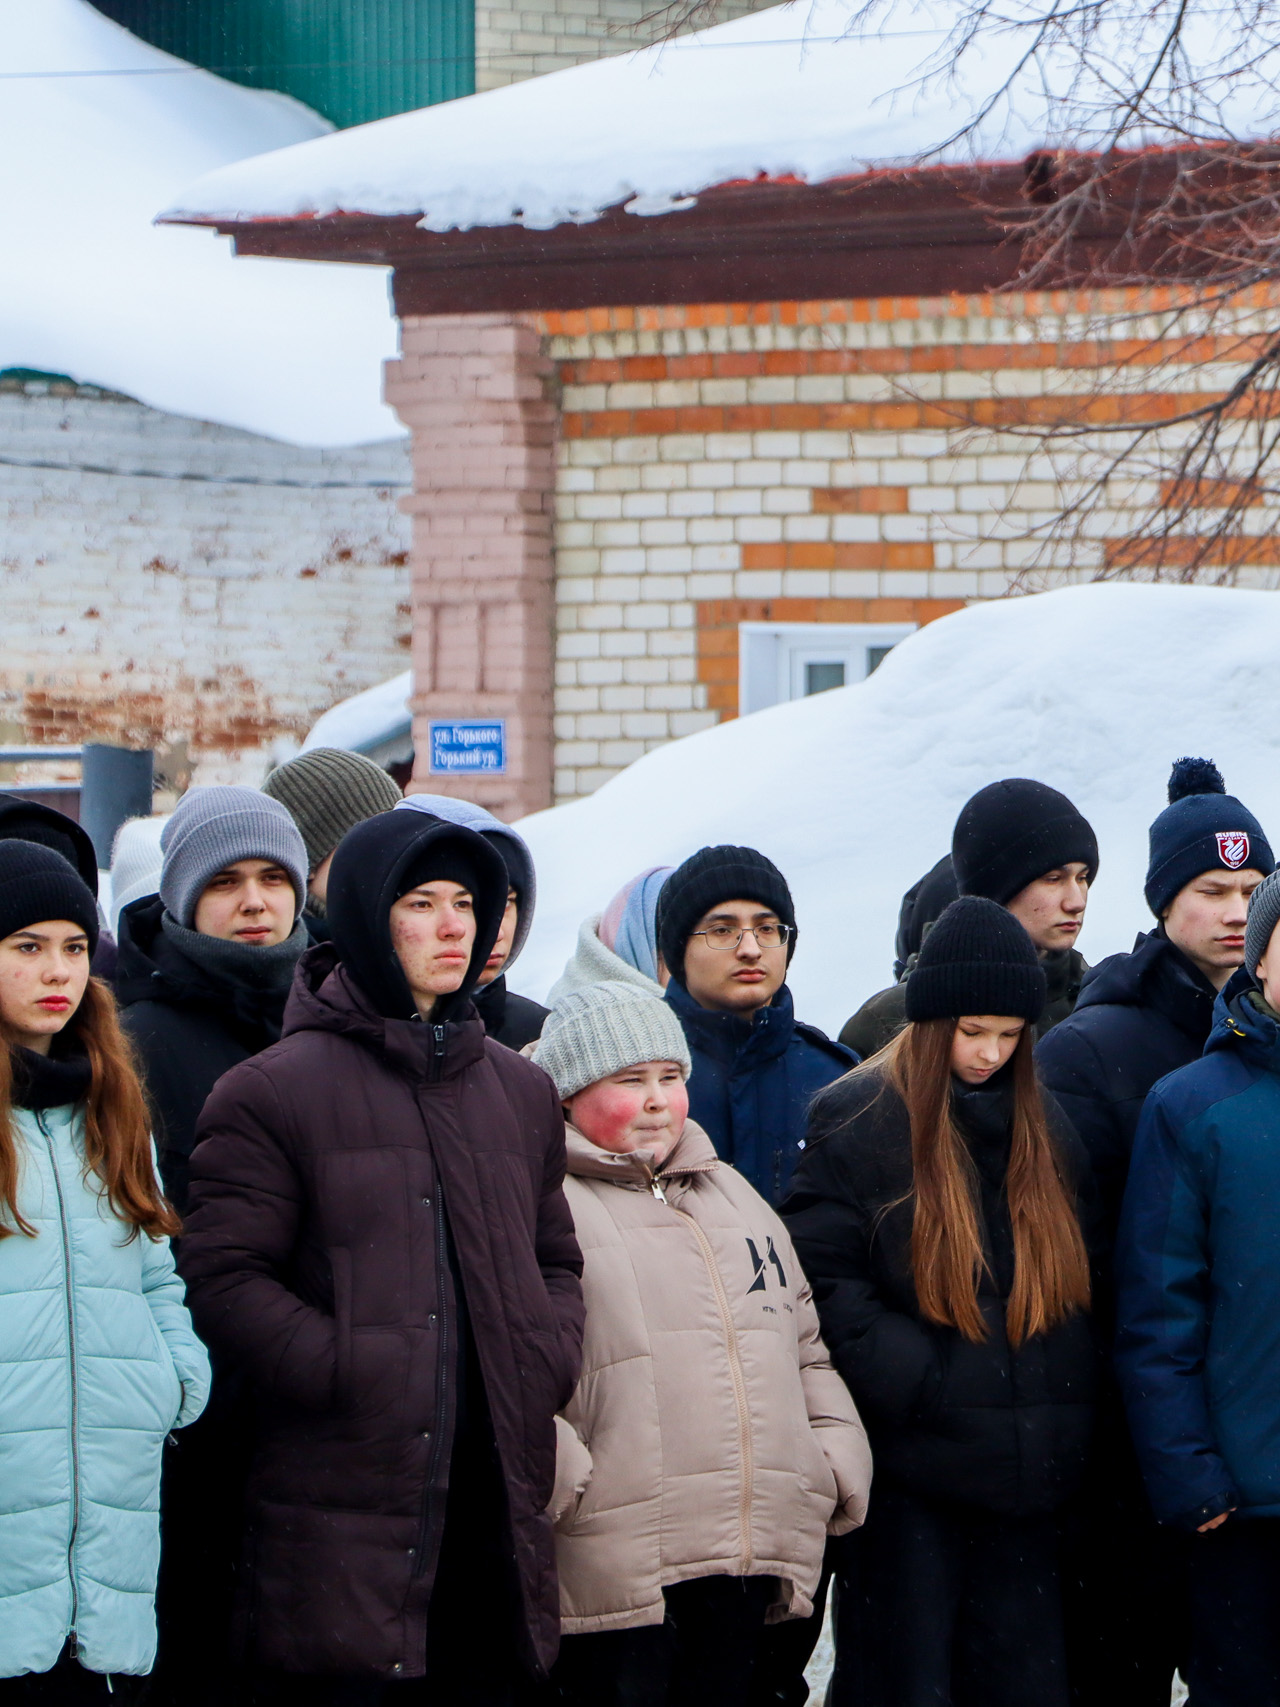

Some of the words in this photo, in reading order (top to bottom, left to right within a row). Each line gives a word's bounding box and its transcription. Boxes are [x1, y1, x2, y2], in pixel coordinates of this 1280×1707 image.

[434, 731, 450, 747] ул.
[452, 727, 497, 748] Горького
[434, 748, 480, 769] Горький
